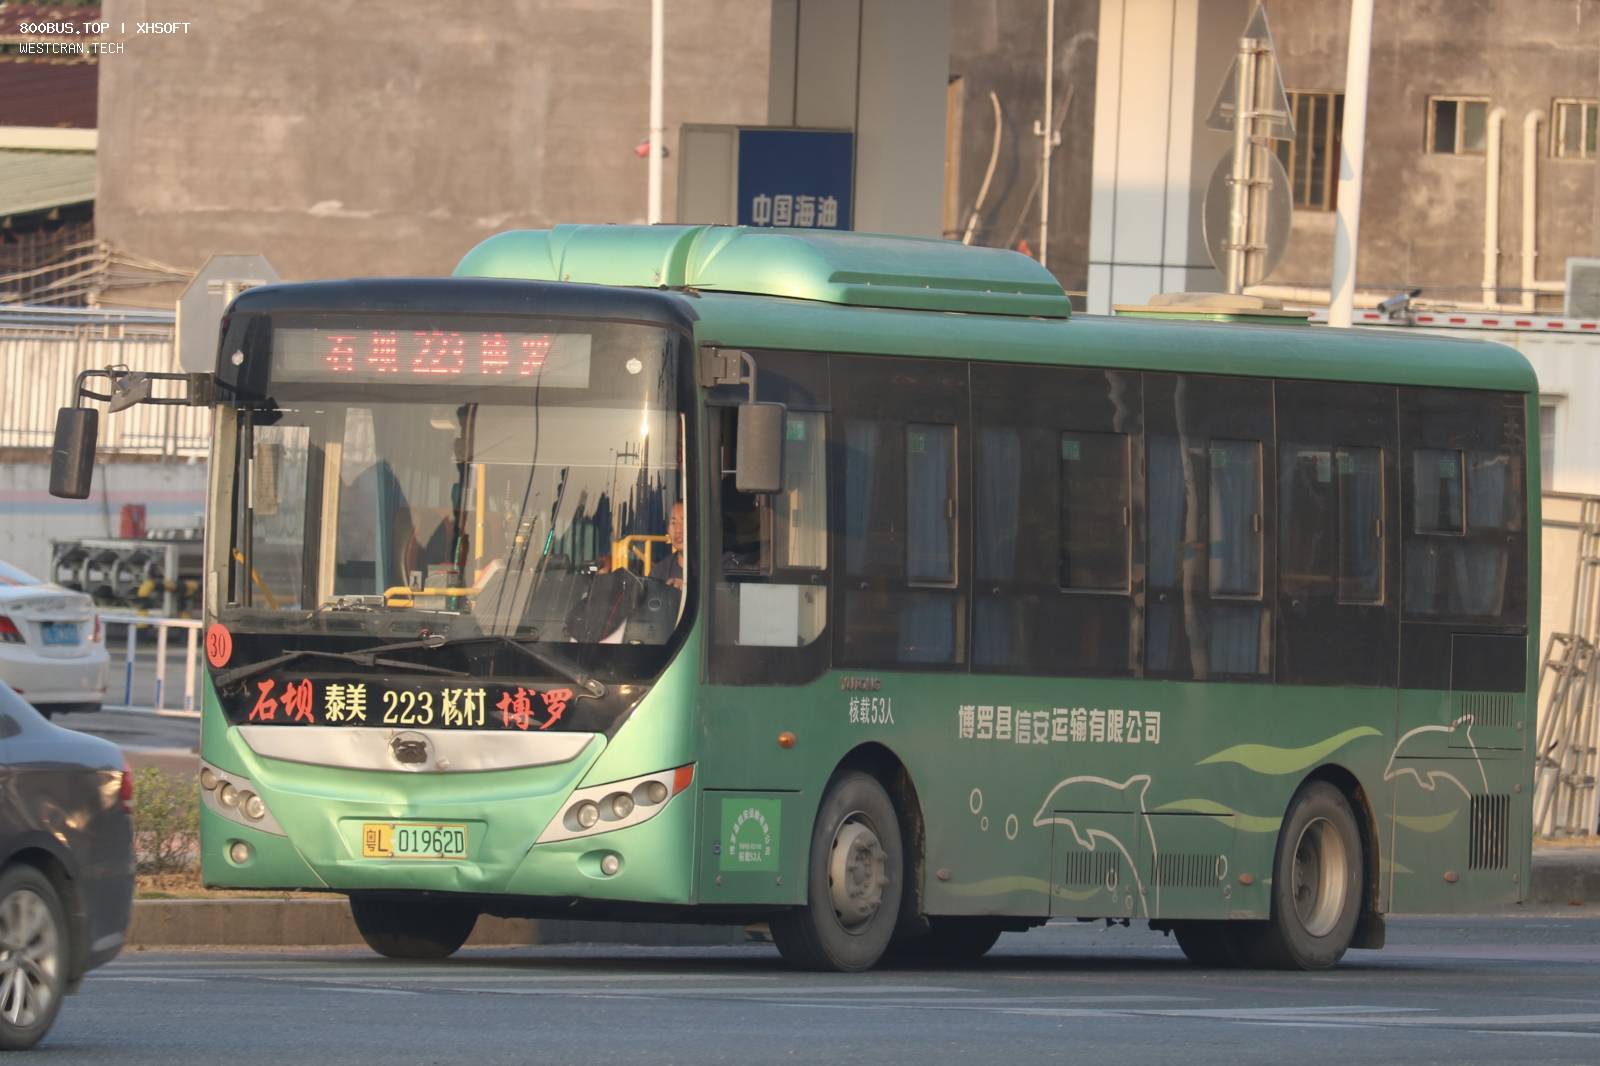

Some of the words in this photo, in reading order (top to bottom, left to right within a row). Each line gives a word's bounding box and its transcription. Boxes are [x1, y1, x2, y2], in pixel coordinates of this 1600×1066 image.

[752, 193, 838, 227] 中国海油
[412, 331, 464, 373] 223
[209, 631, 227, 658] 30
[248, 678, 316, 723] 石坝
[324, 683, 367, 722] 泰美
[382, 689, 434, 726] 223
[441, 687, 487, 727] 杨村
[495, 687, 573, 730] 博罗
[849, 696, 895, 724] 核载53人
[958, 704, 1161, 745] 博罗县信安运输有限公司
[366, 829, 389, 852] 粤L
[399, 830, 464, 853] 01962D
